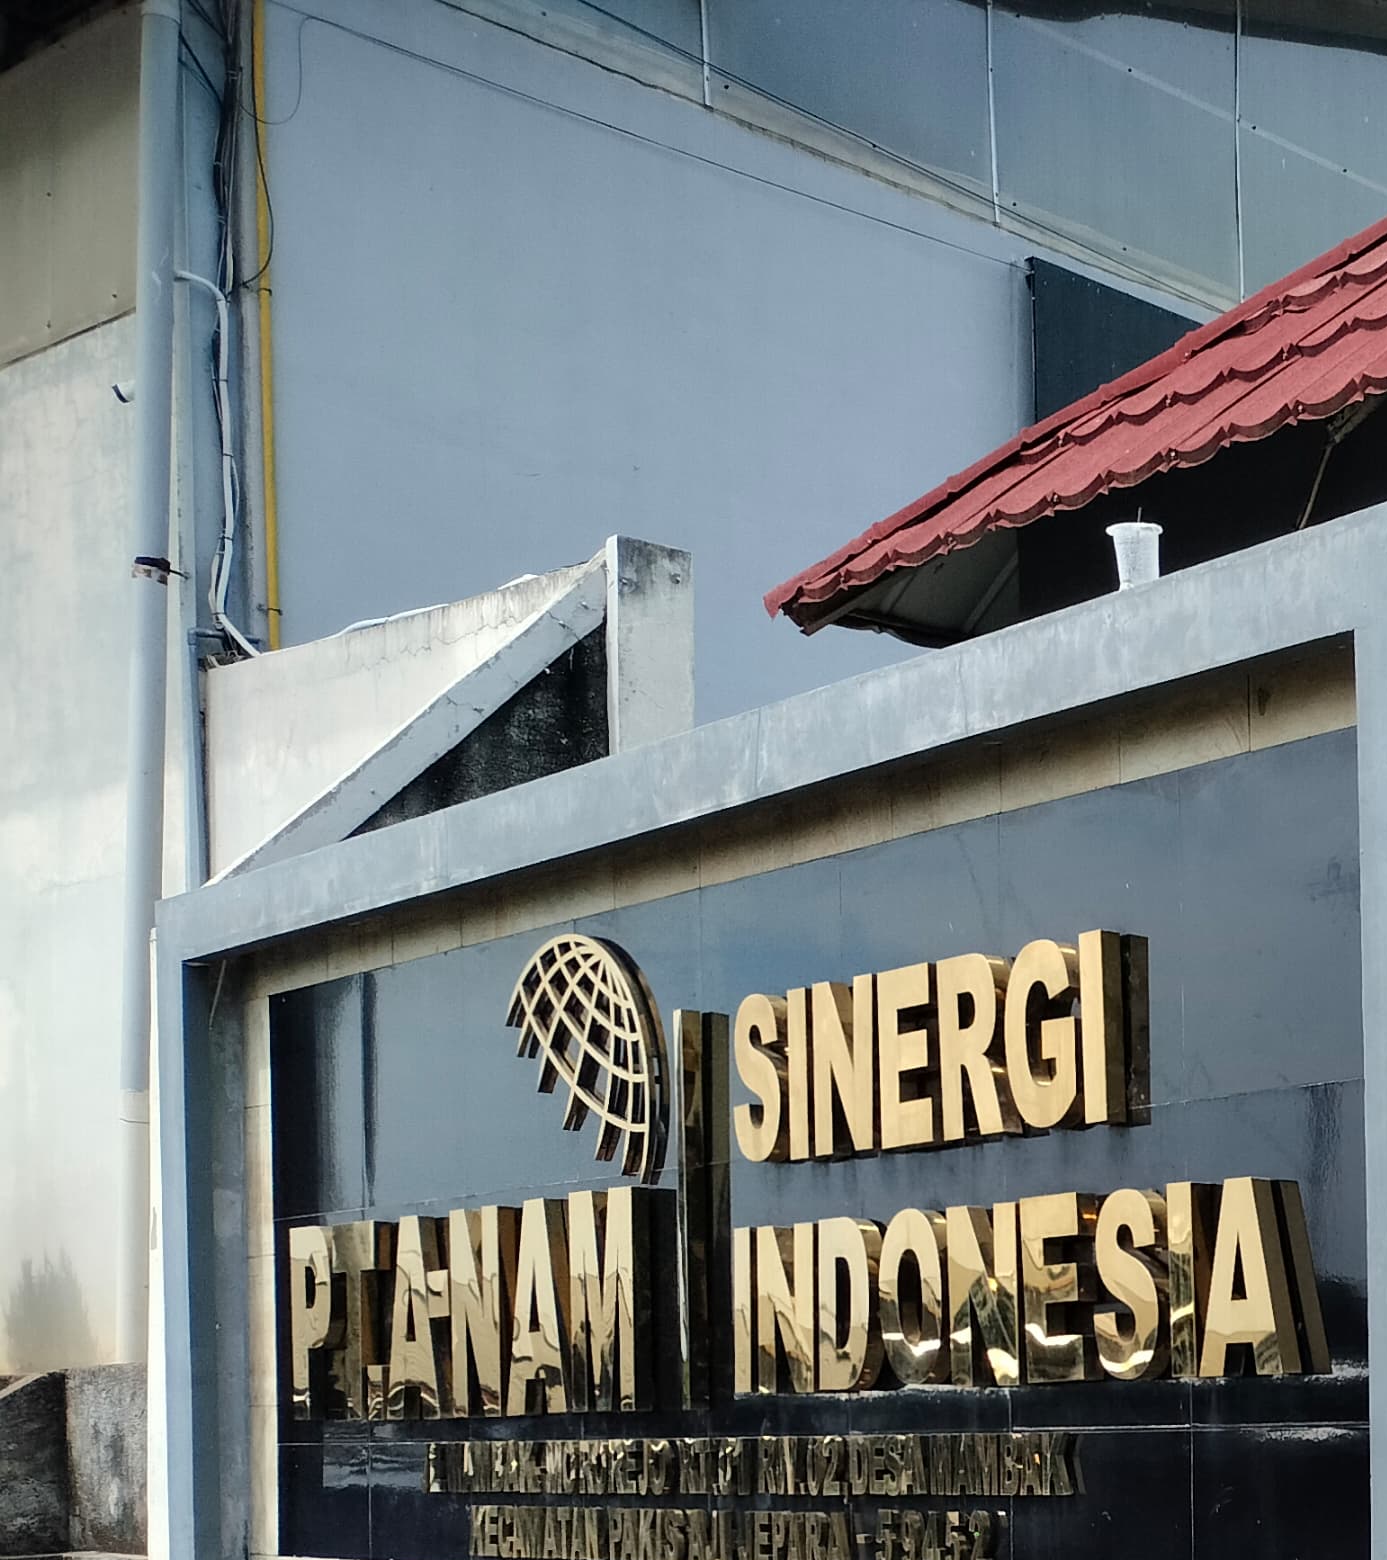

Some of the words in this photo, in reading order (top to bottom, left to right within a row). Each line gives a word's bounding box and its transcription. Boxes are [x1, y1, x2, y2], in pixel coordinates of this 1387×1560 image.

[734, 928, 1125, 1163] SINERGI
[734, 1176, 1292, 1393] INDONESIA
[850, 1433, 928, 1496] DESA
[930, 1432, 1076, 1496] MAMBAK
